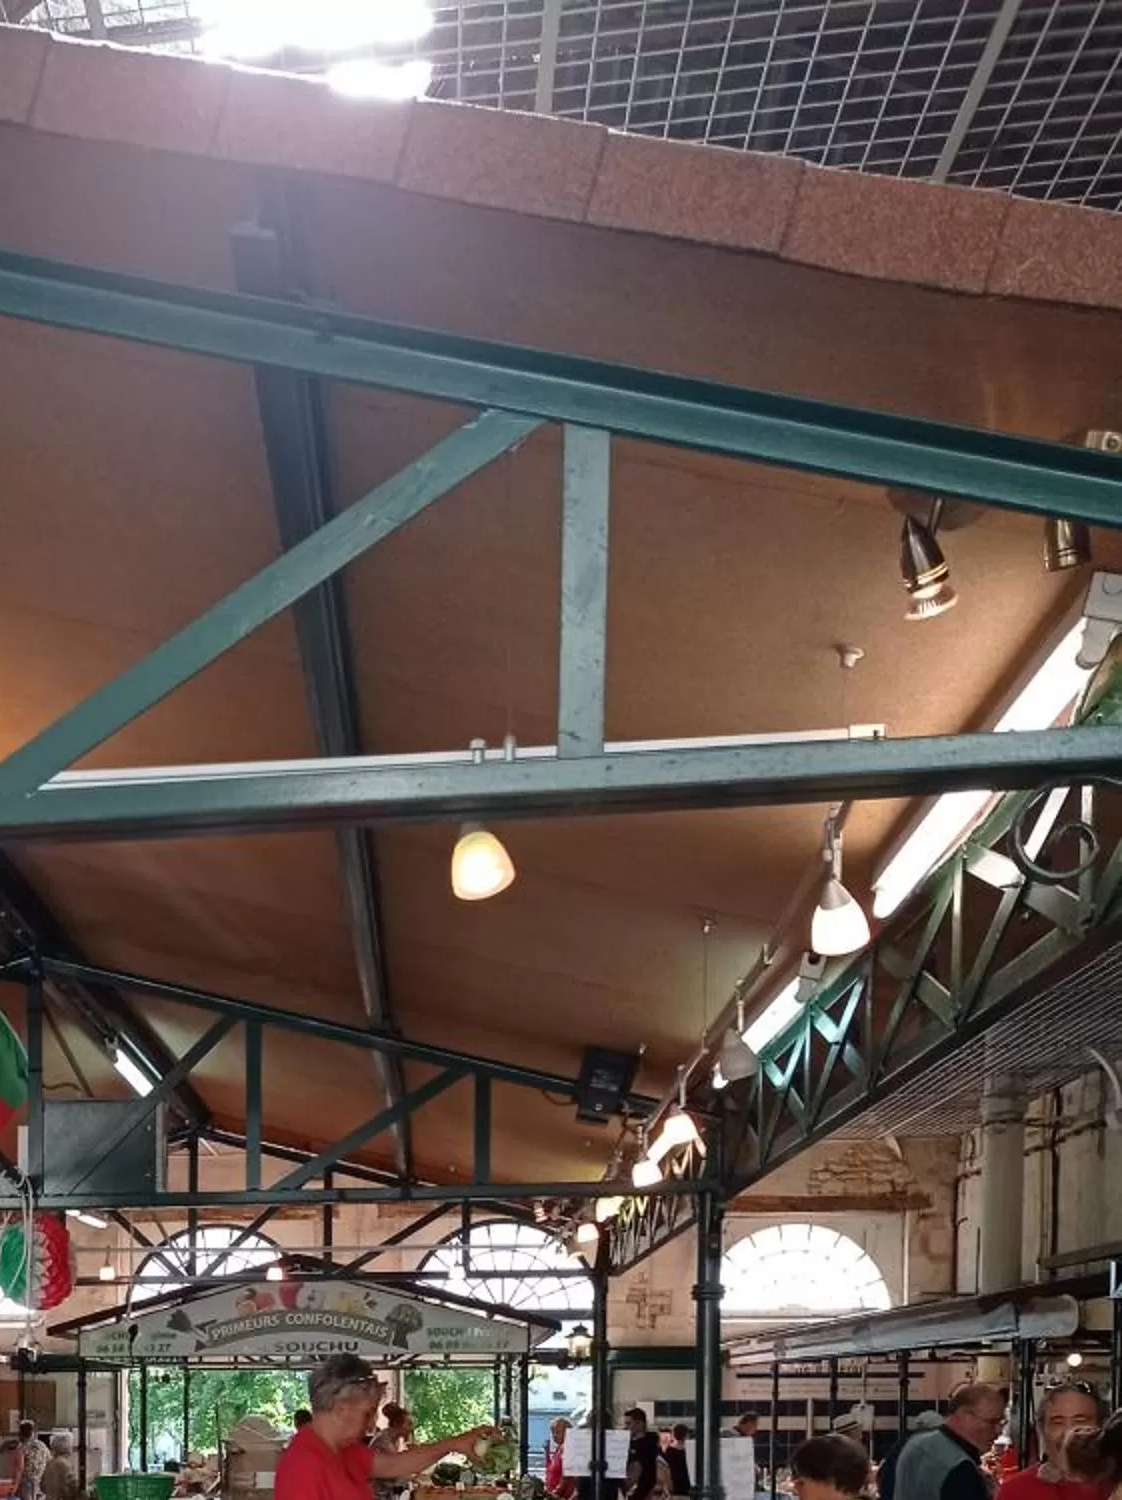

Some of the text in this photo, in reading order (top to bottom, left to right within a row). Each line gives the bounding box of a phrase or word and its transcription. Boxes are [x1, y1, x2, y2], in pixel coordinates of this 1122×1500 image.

[211, 1313, 389, 1340] PRIMEURS CONFOLENTAIS
[275, 1341, 359, 1352] SOUCHU
